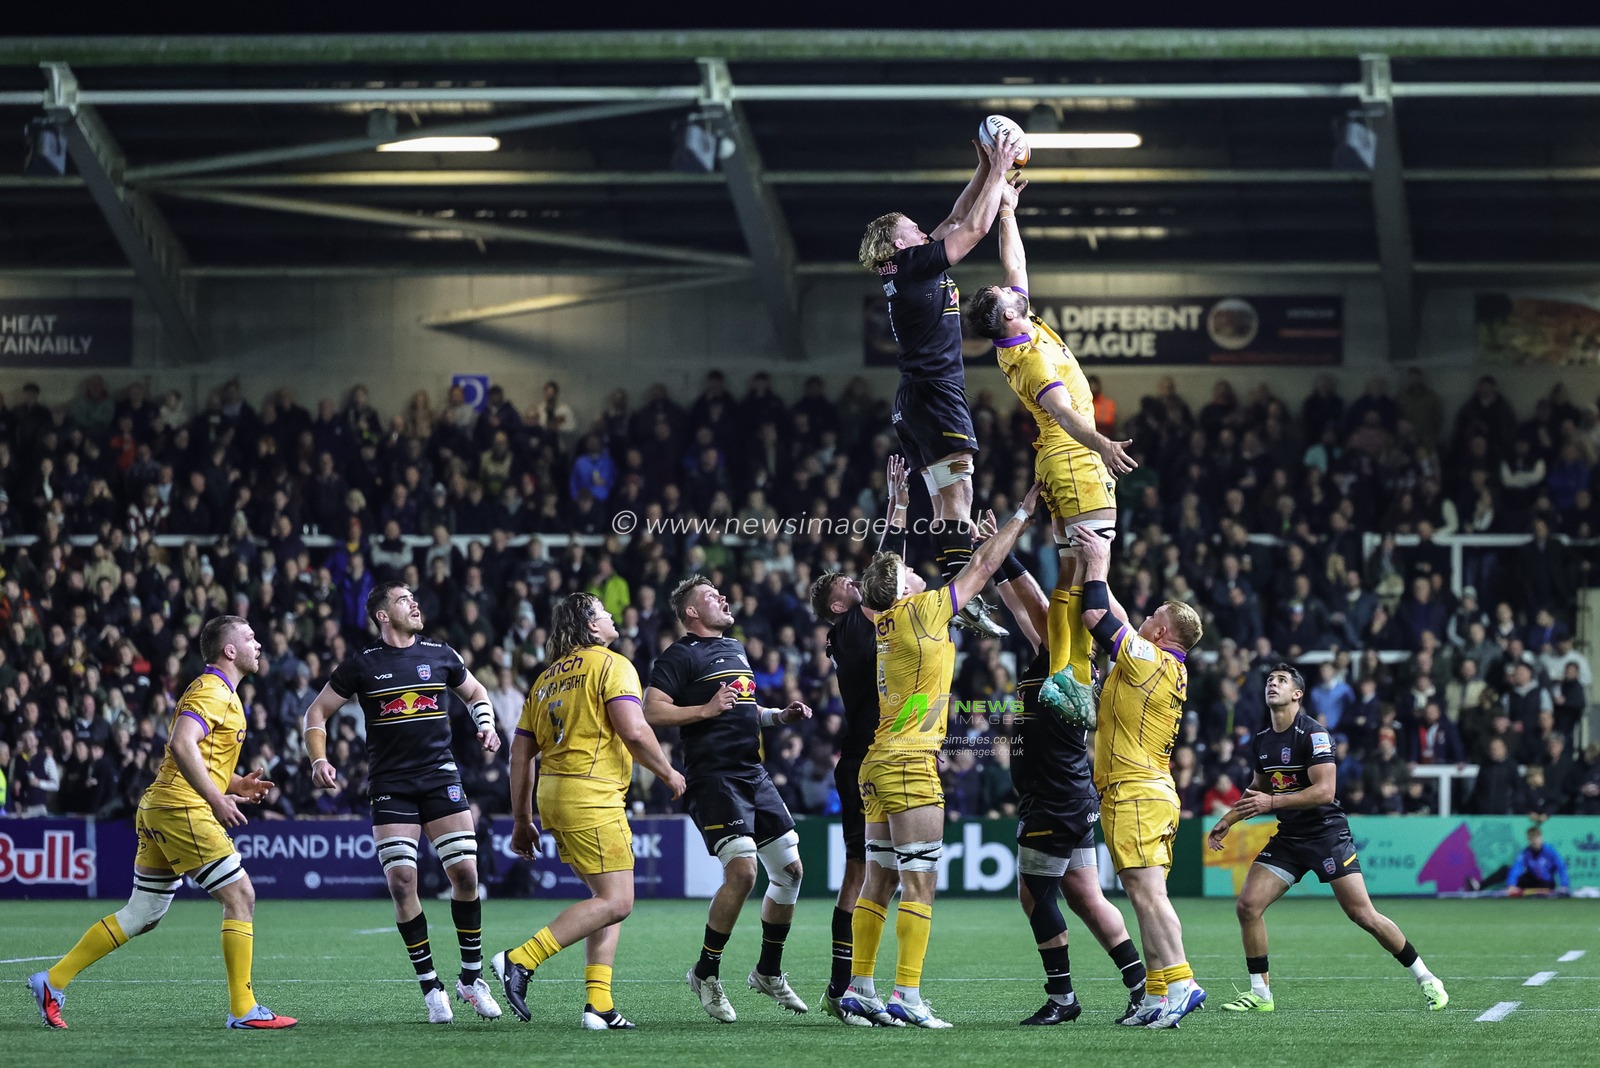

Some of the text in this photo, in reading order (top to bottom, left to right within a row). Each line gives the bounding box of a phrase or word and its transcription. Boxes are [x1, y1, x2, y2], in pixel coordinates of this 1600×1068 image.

[2, 314, 57, 335] HEAT
[1061, 305, 1203, 332] DIFFERENT
[1063, 332, 1157, 358] EAGUE
[548, 699, 565, 745] 5
[233, 834, 330, 859] GRAND
